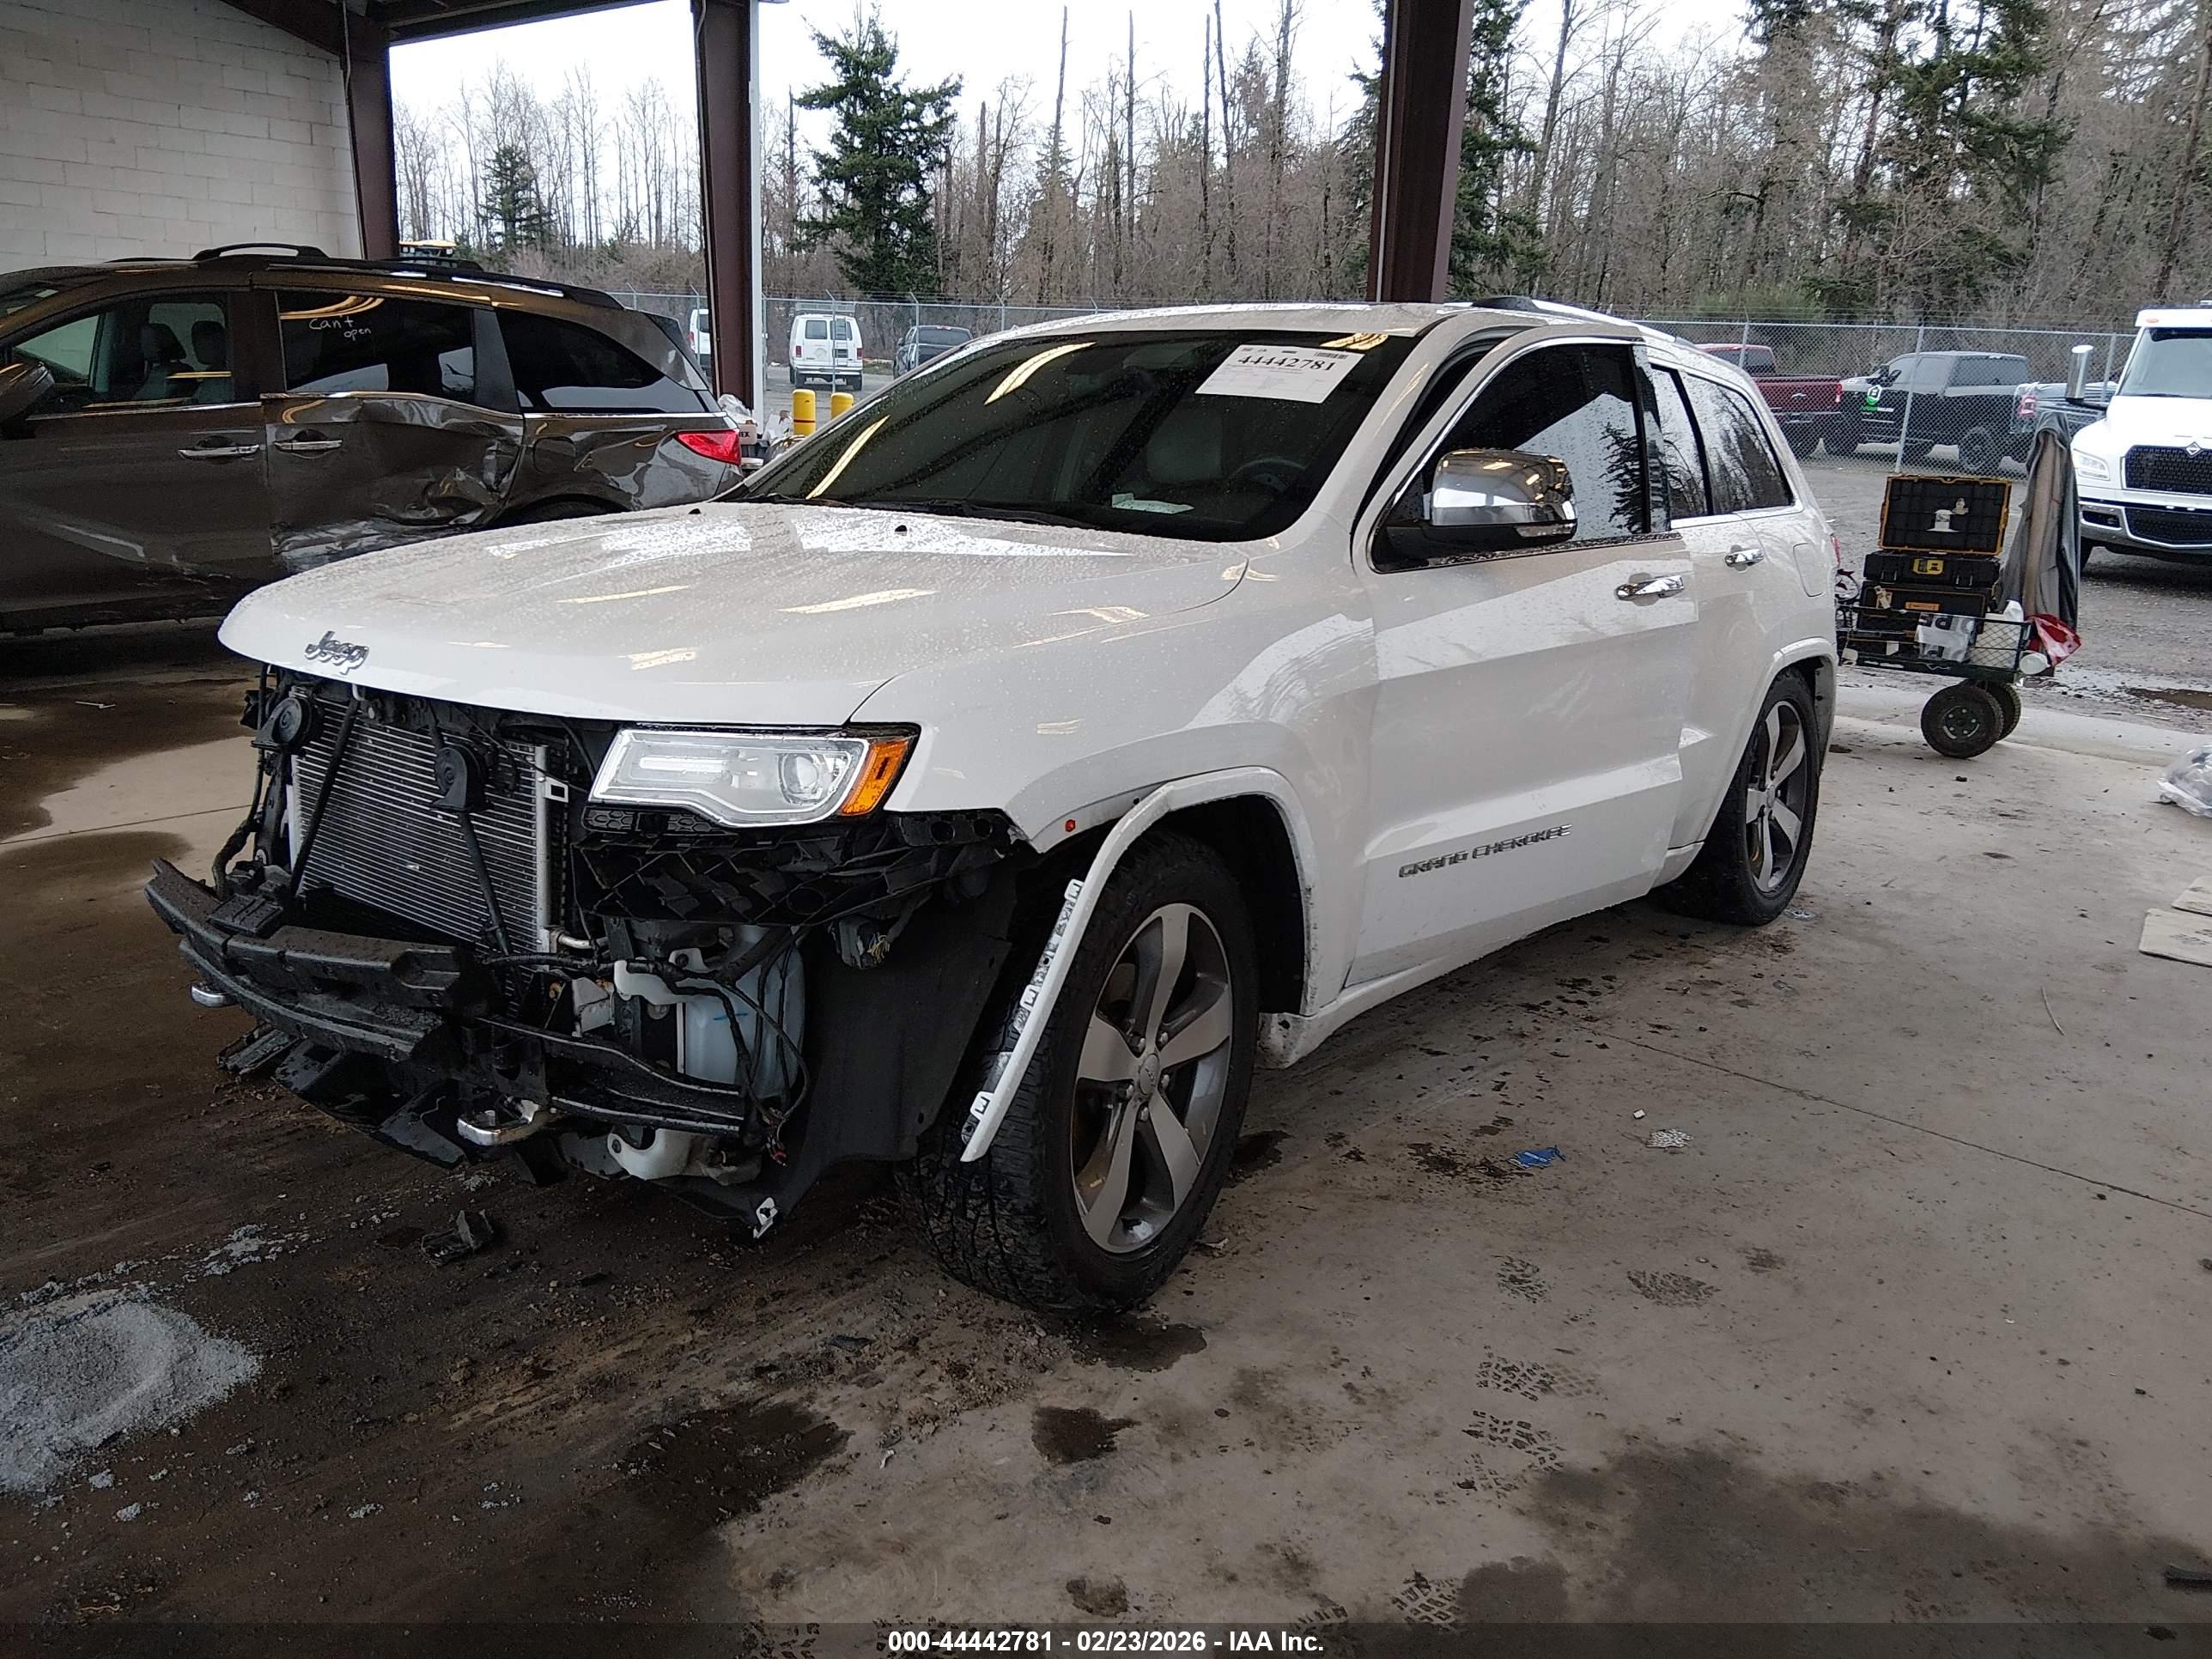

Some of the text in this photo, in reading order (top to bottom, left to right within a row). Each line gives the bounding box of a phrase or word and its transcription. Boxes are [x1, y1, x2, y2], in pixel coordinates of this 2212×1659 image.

[343, 327, 372, 341] open
[1237, 355, 1337, 371] 44442781
[304, 630, 369, 676] Jeep
[1399, 823, 1573, 878] GRAND CHEROKEE
